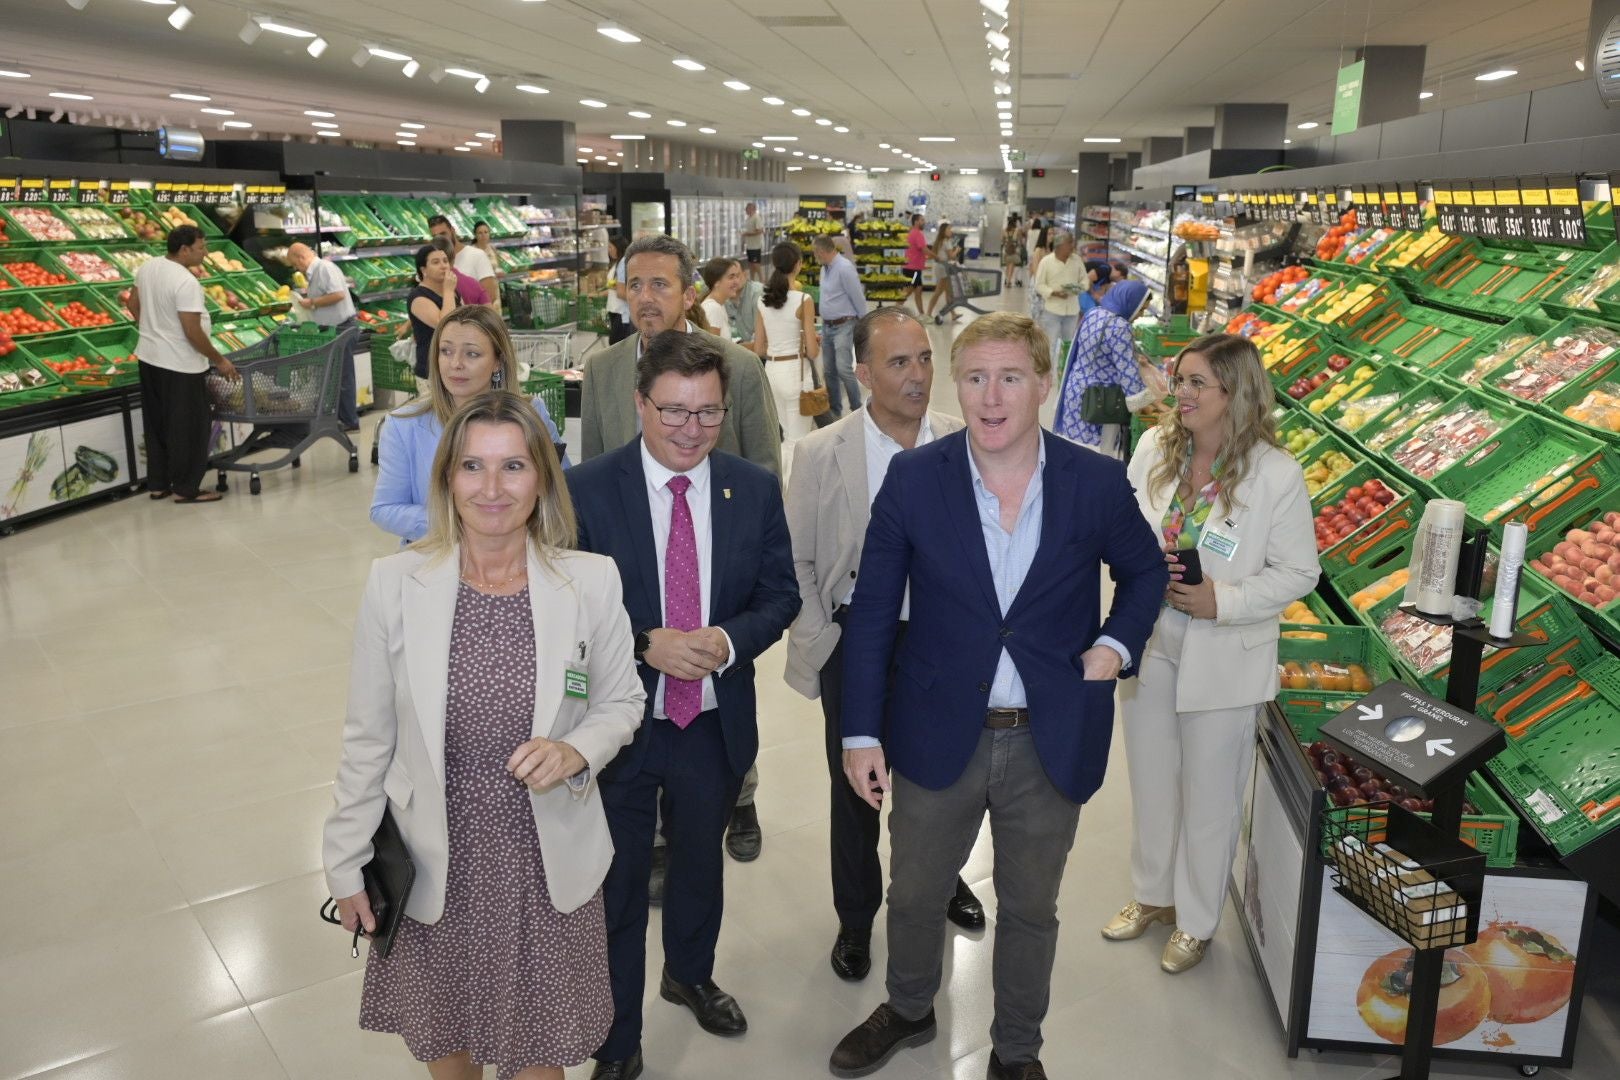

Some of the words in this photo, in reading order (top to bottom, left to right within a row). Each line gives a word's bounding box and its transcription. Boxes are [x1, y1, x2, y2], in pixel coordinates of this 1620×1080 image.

[1400, 692, 1427, 707] FRUTAS
[1431, 706, 1469, 726] VERDURAS
[1417, 706, 1443, 722] GRANEL
